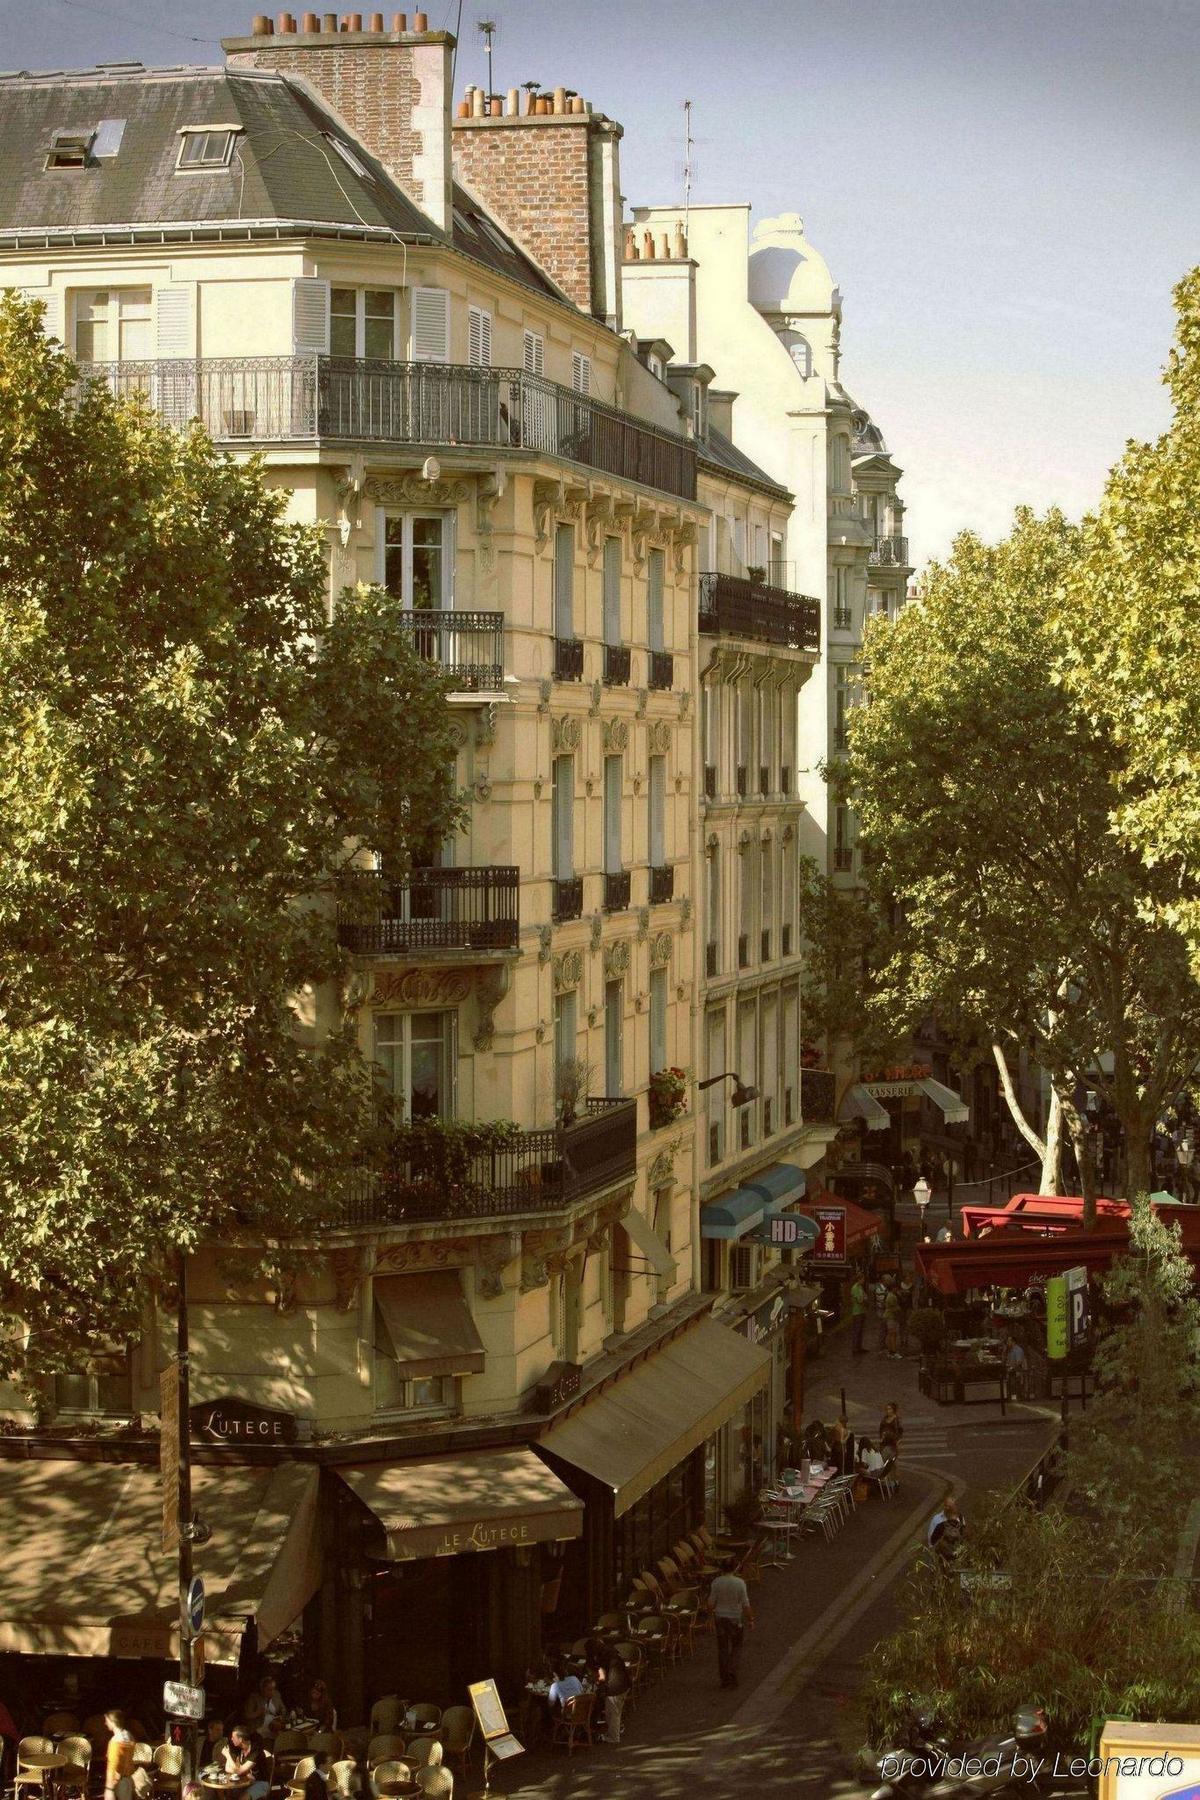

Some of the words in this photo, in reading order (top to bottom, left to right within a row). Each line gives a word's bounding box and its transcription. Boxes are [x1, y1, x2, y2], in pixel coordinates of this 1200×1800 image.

[868, 1086, 914, 1097] RASSERIE
[771, 1219, 797, 1243] HD
[1073, 1293, 1084, 1334] P
[444, 1533, 460, 1547] LE
